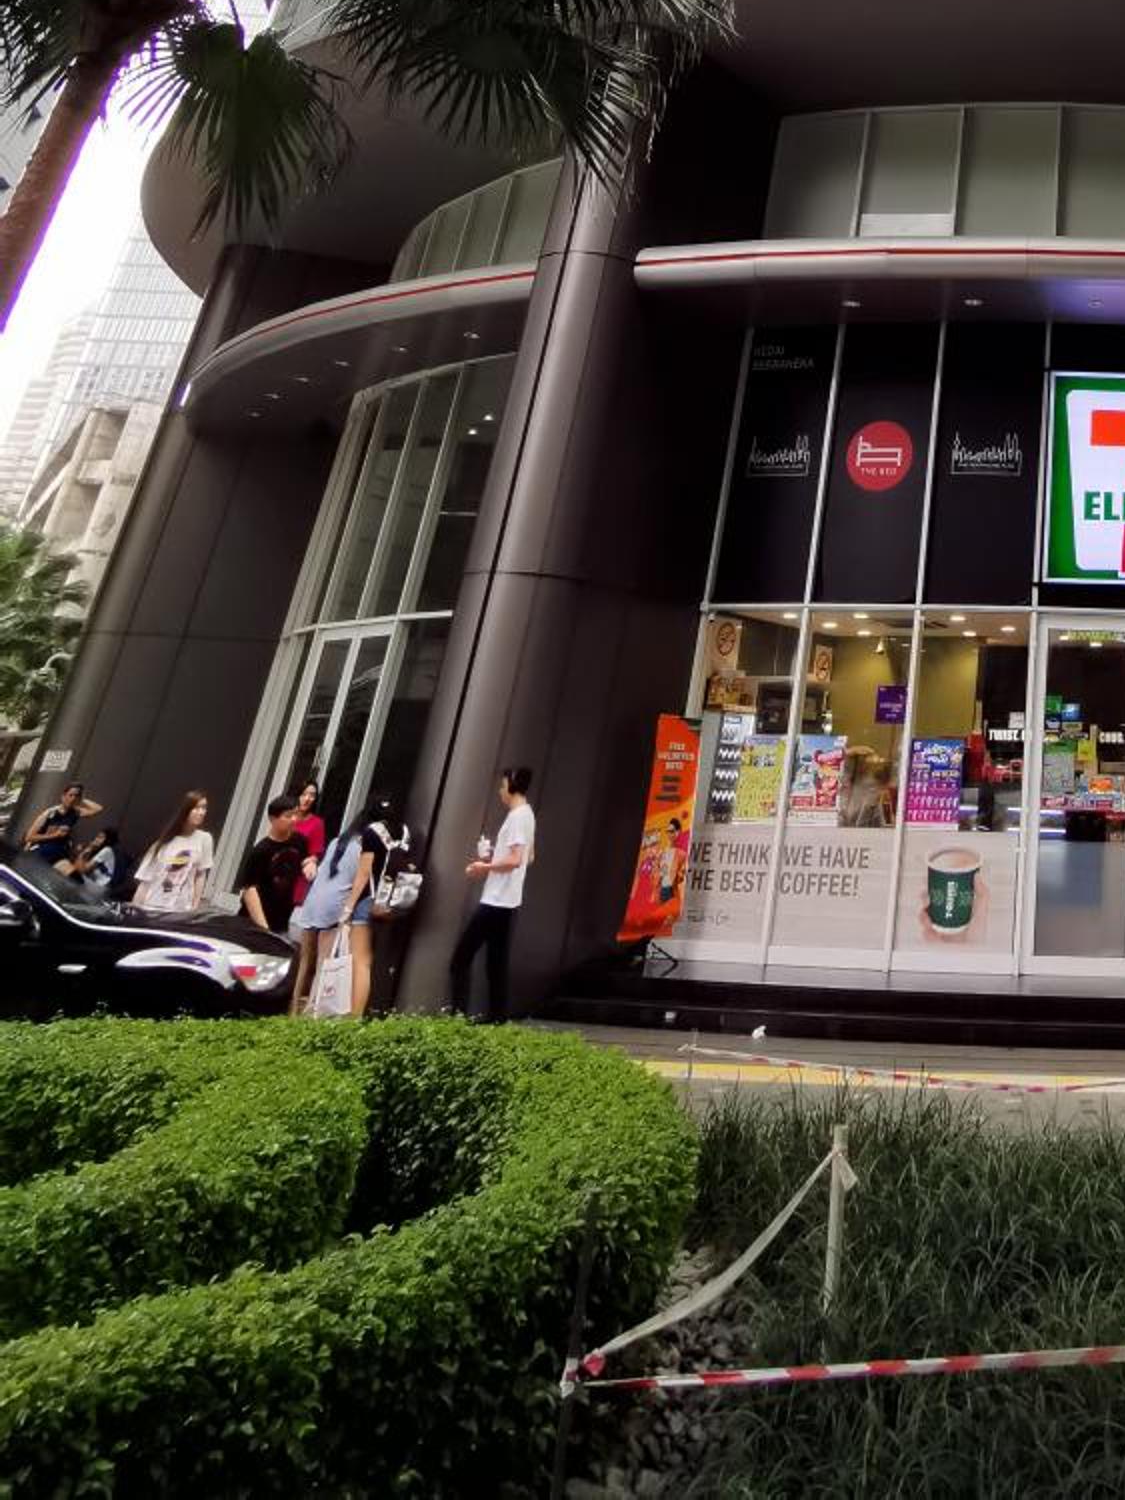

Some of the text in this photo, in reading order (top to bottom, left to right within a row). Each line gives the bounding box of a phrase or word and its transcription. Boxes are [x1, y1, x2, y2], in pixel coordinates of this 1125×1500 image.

[718, 843, 771, 865] THINK
[785, 846, 813, 866] WE
[820, 847, 870, 868] HAVE
[720, 871, 766, 892] BEST
[779, 872, 860, 896] COFFEE!
